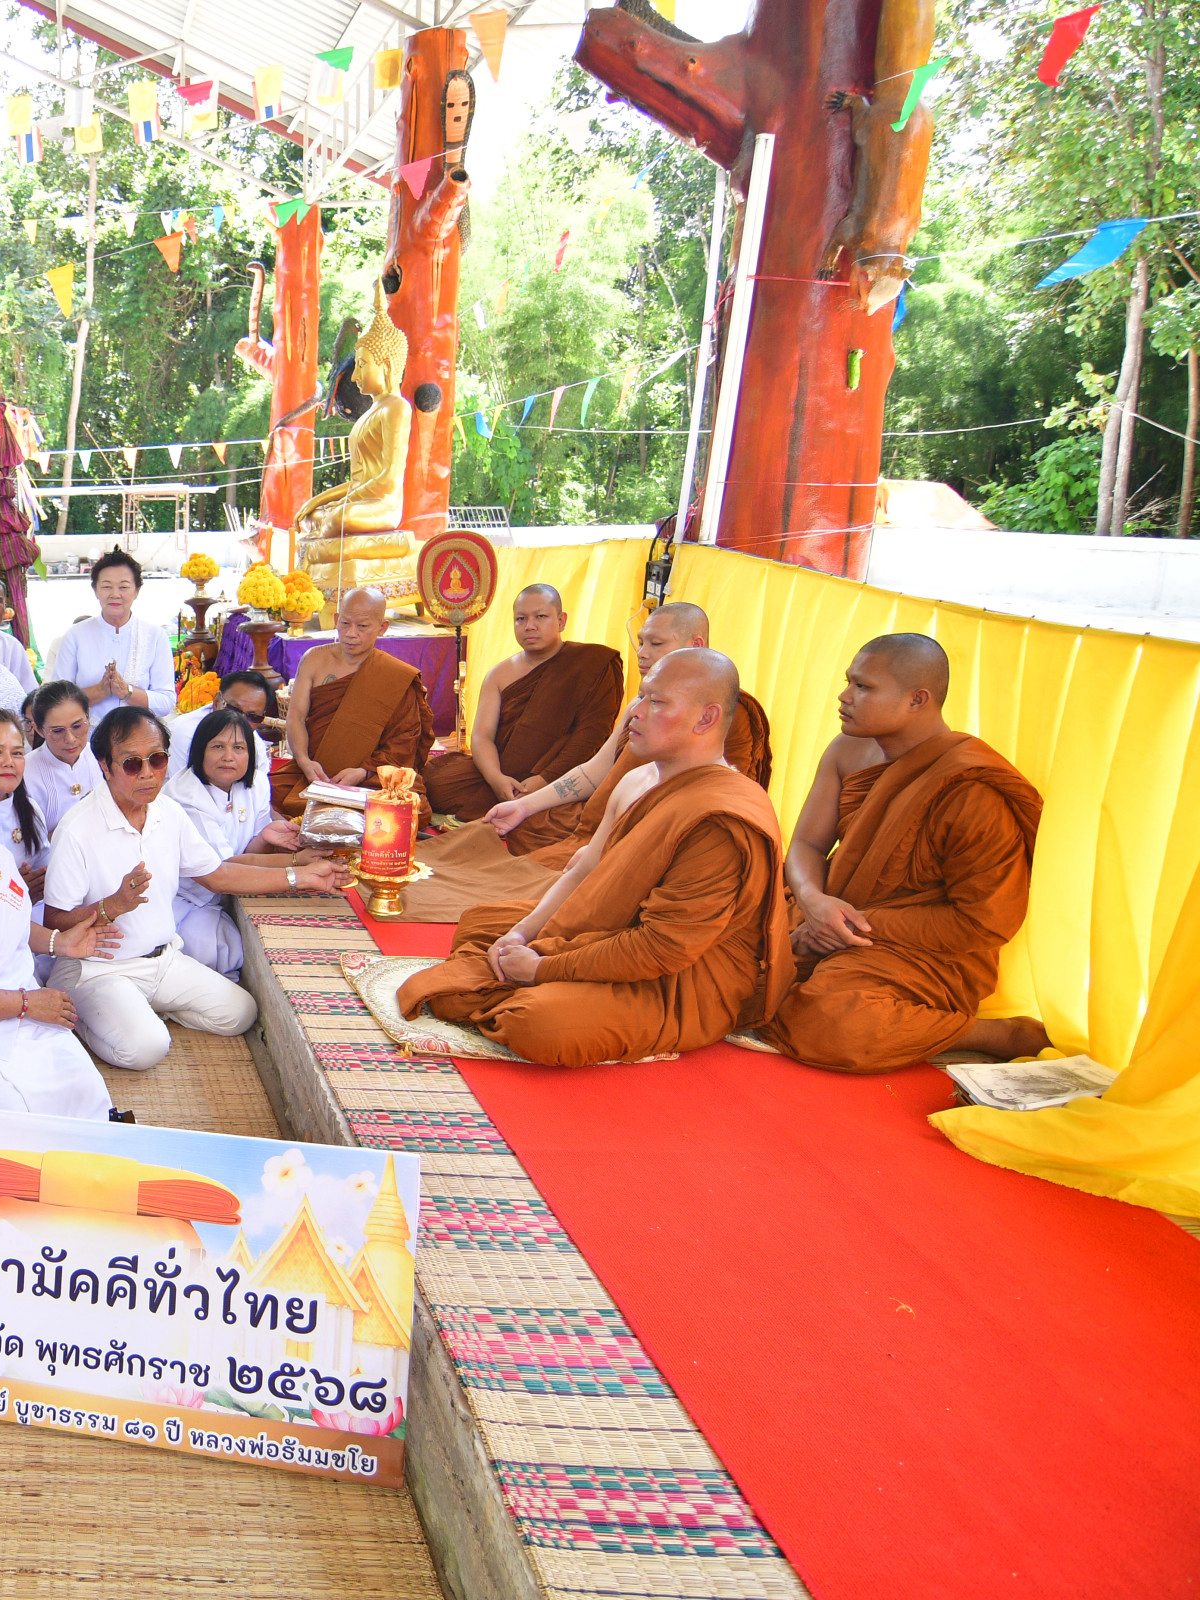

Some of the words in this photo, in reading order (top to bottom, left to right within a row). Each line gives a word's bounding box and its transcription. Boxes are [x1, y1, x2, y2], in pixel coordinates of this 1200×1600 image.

[35, 1338, 211, 1388] พุทธศักราช
[226, 1355, 389, 1414] ๒๕๖๘
[14, 1399, 117, 1433] บูชาธรรม
[124, 1419, 157, 1440] ๘๑
[165, 1419, 181, 1443] ปี
[189, 1427, 376, 1474] หลวงพ่อธัมมชโย
